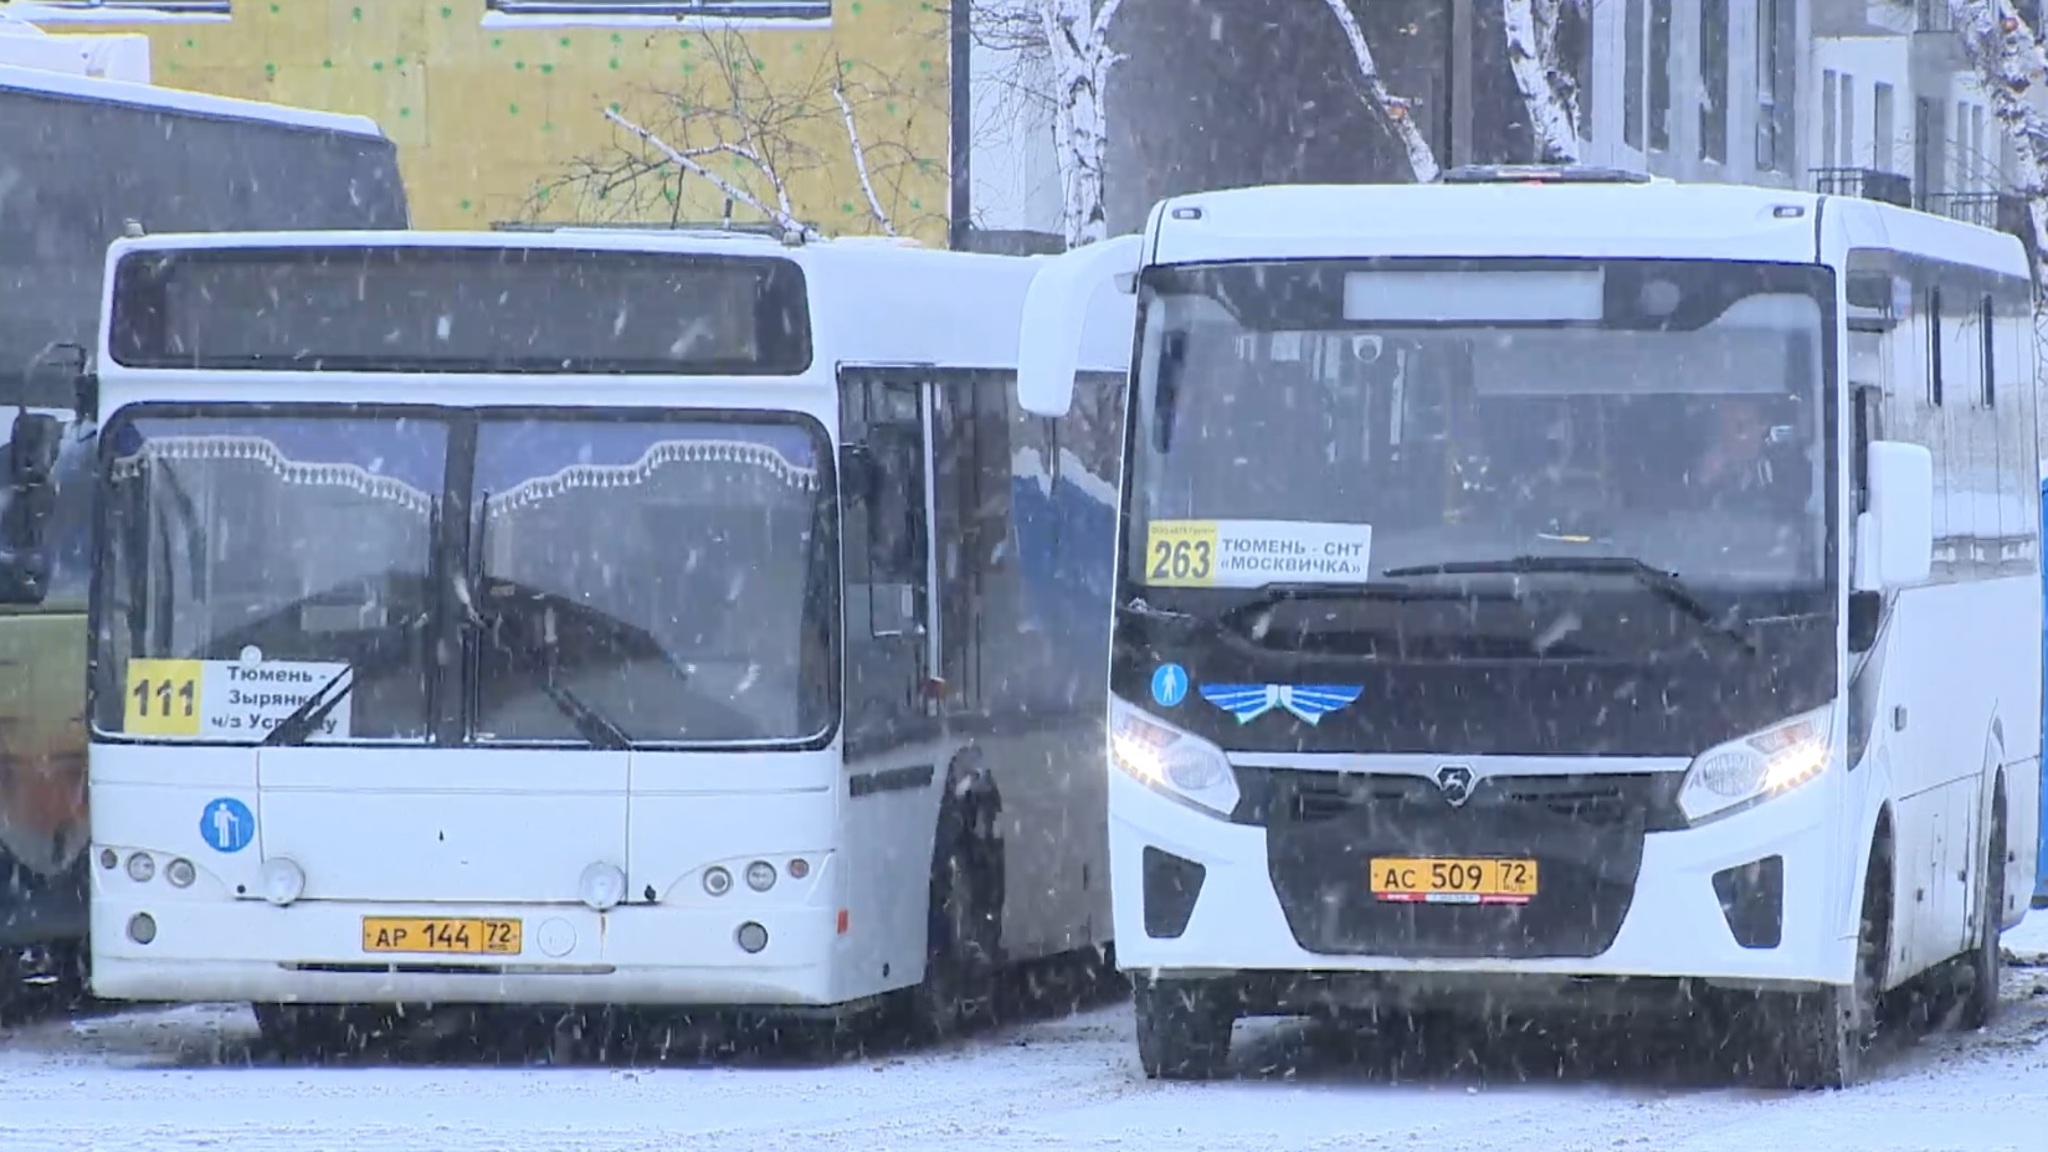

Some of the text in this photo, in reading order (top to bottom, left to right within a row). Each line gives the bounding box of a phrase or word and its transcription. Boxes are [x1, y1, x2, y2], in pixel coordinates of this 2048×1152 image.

[1222, 539, 1306, 555] ТЮМЕНЬ
[1324, 542, 1363, 557] СНТ
[1153, 540, 1210, 579] 263
[1221, 556, 1361, 574] «МОСКВИЧКА»
[227, 665, 313, 683] Тюмень
[134, 679, 195, 717] 111
[211, 715, 242, 730] ч/з
[1384, 863, 1527, 890] АС 509 72
[376, 923, 512, 949] АР 144 72
